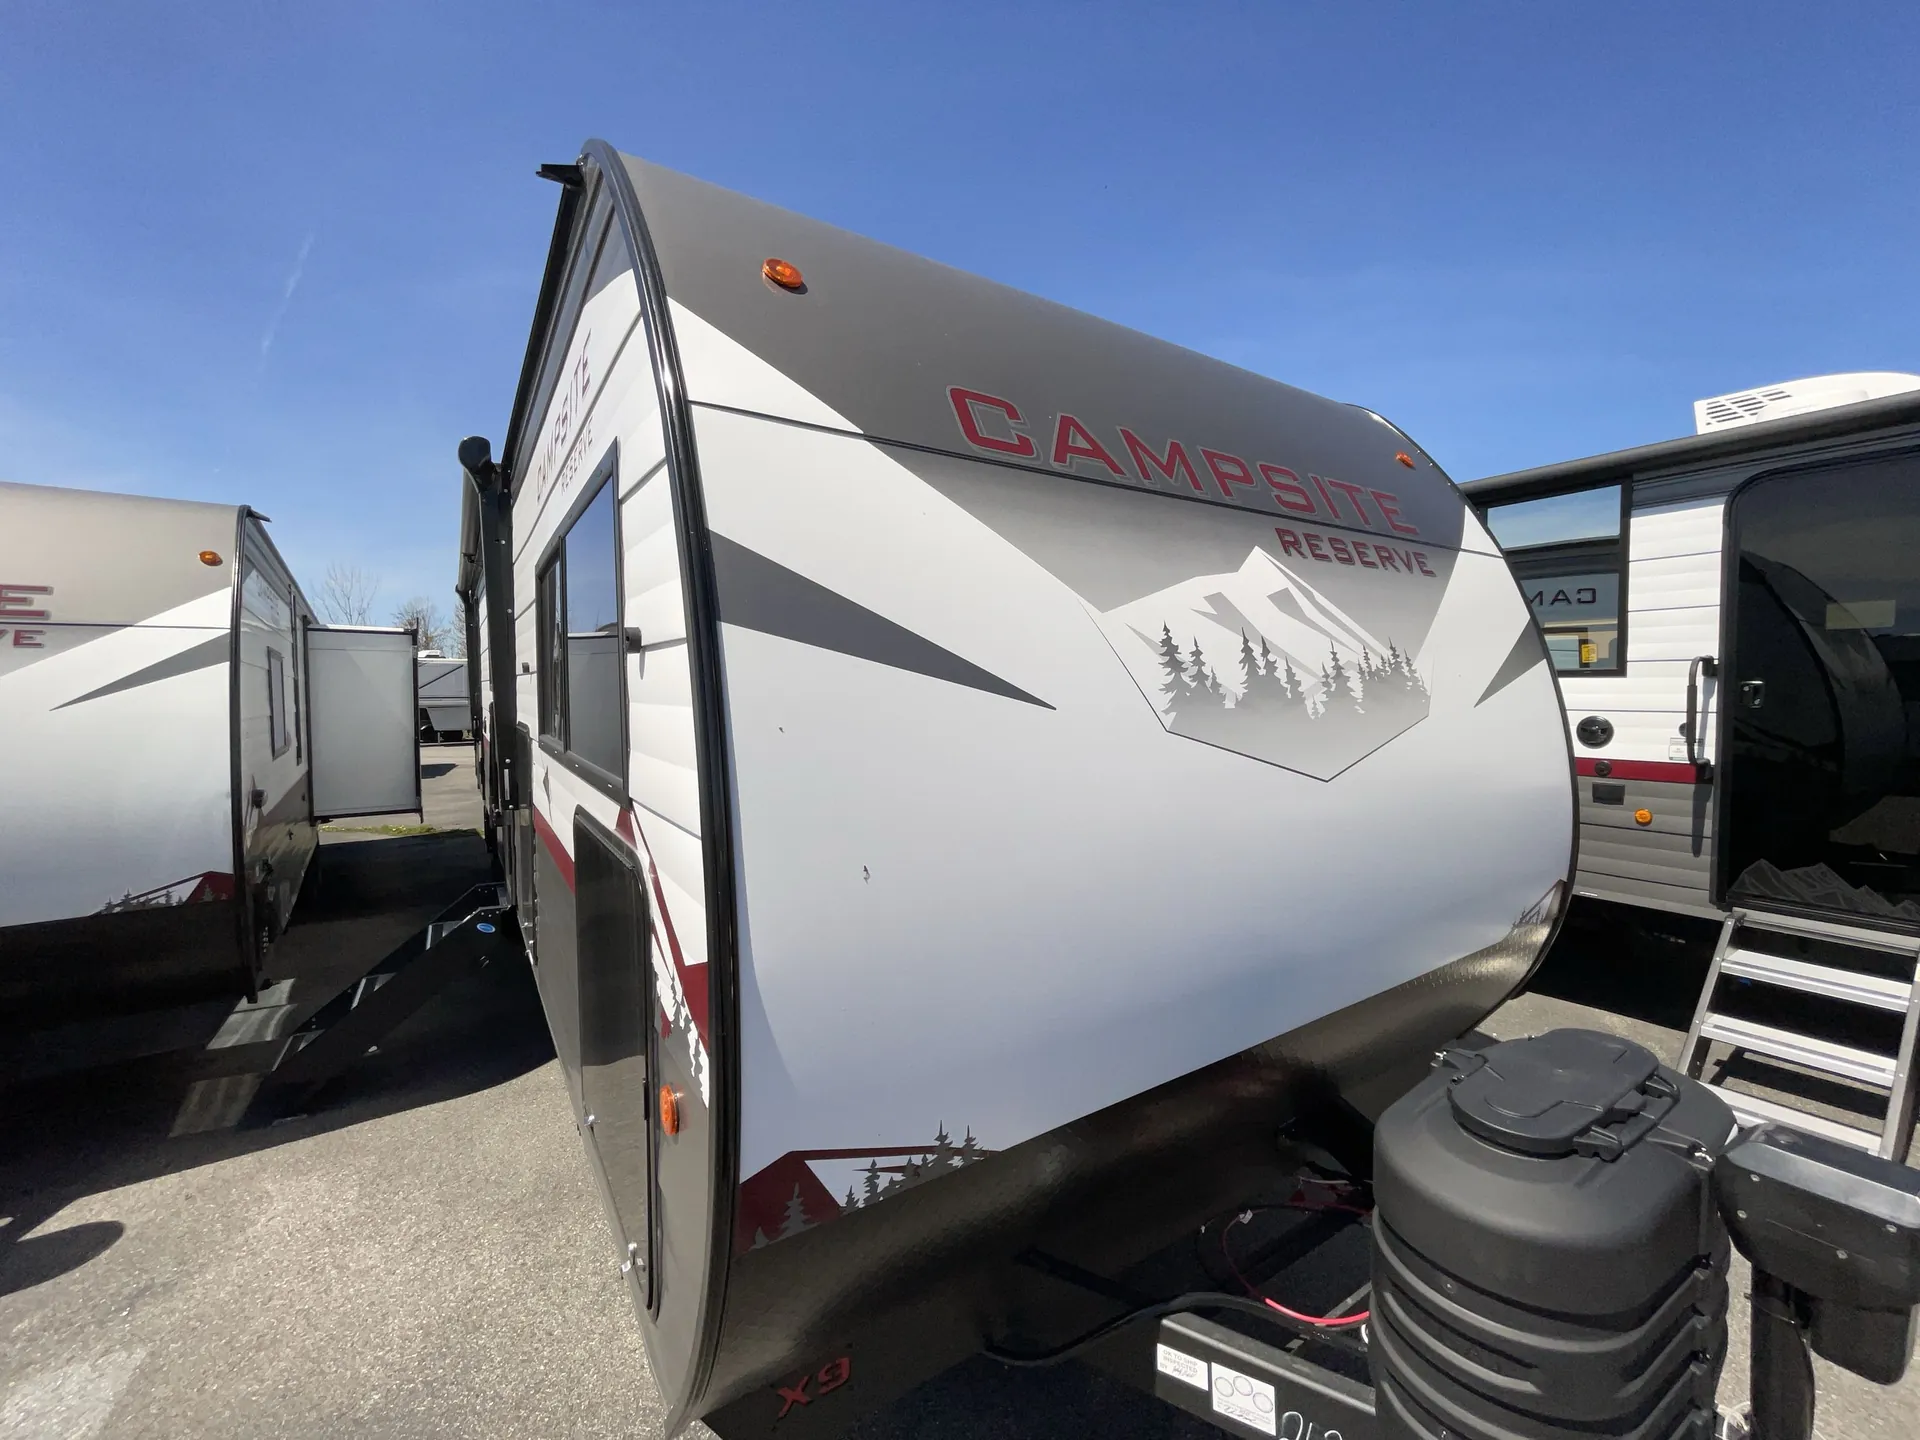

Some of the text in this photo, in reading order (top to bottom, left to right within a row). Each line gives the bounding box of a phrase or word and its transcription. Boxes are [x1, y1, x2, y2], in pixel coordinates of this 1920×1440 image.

[946, 384, 1420, 535] CAMPSITE
[1275, 527, 1437, 577] RESERVE
[776, 1357, 851, 1420] X9
